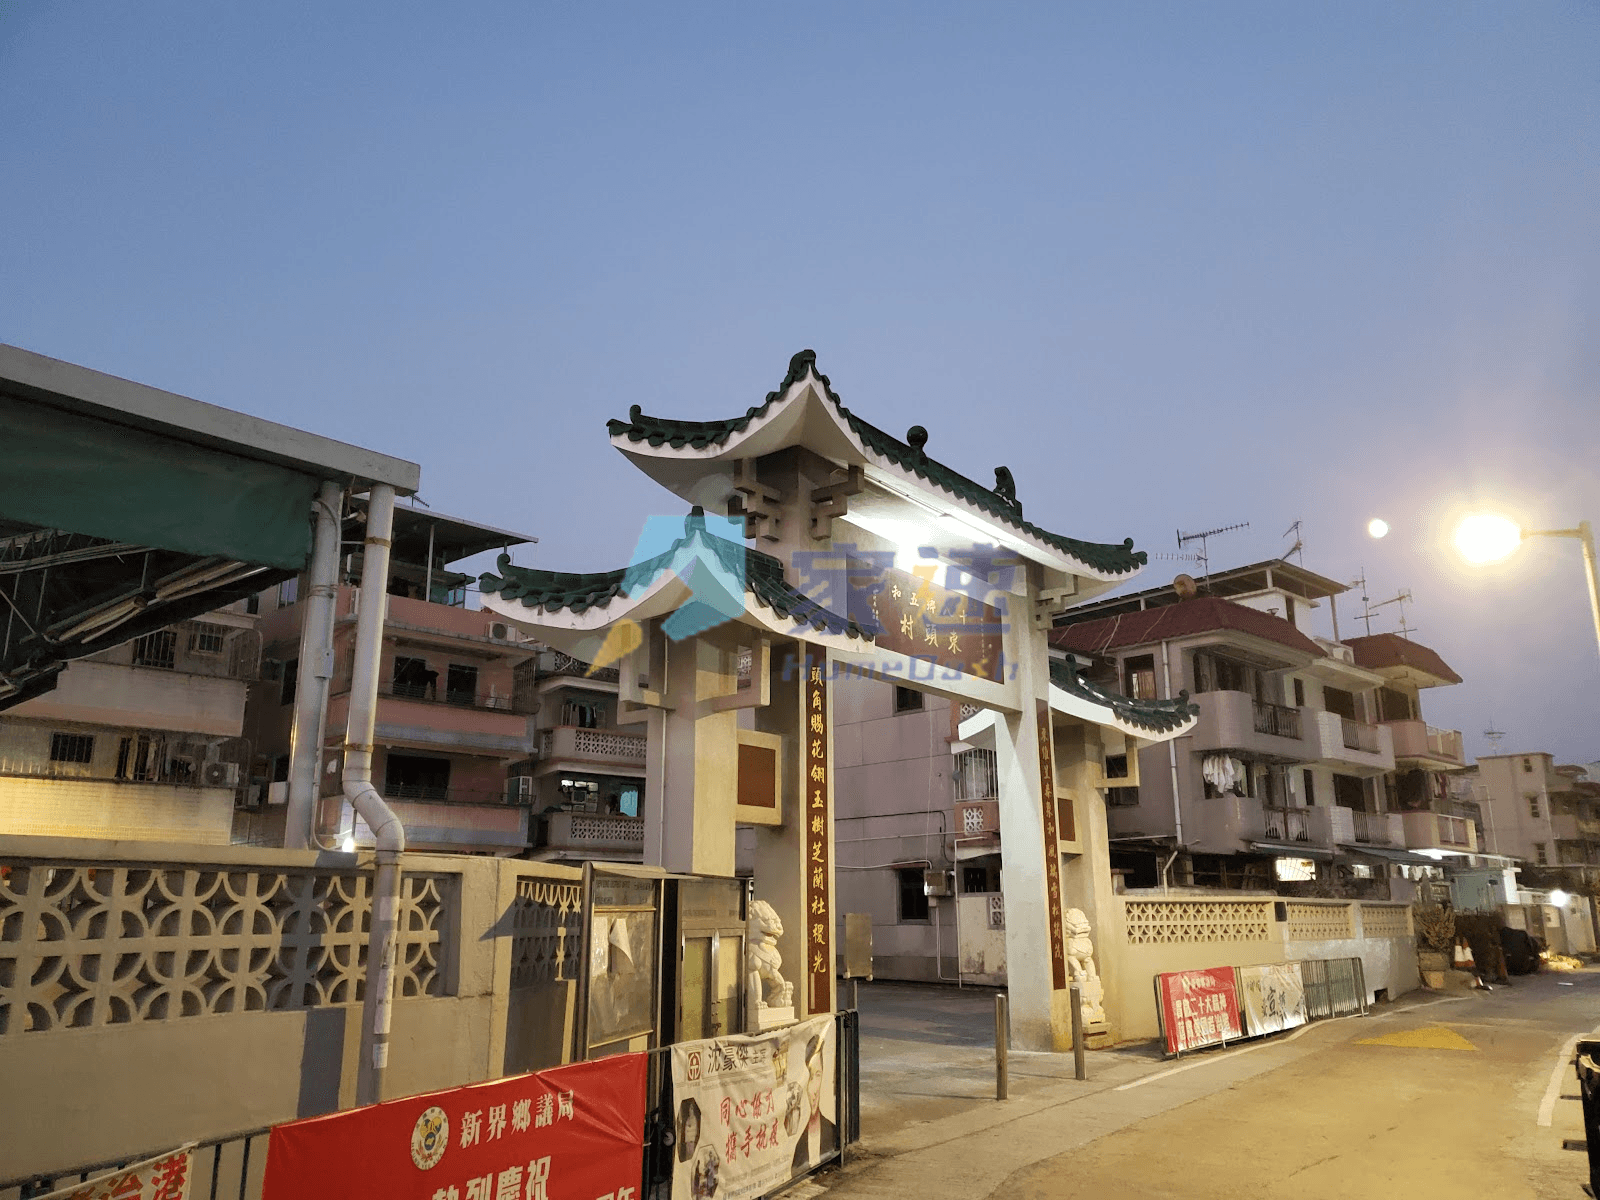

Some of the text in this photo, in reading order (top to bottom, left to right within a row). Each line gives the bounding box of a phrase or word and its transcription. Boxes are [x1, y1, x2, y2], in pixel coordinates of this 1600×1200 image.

[900, 614, 962, 654] 東頭村
[459, 1089, 575, 1150] 新界鄉議局
